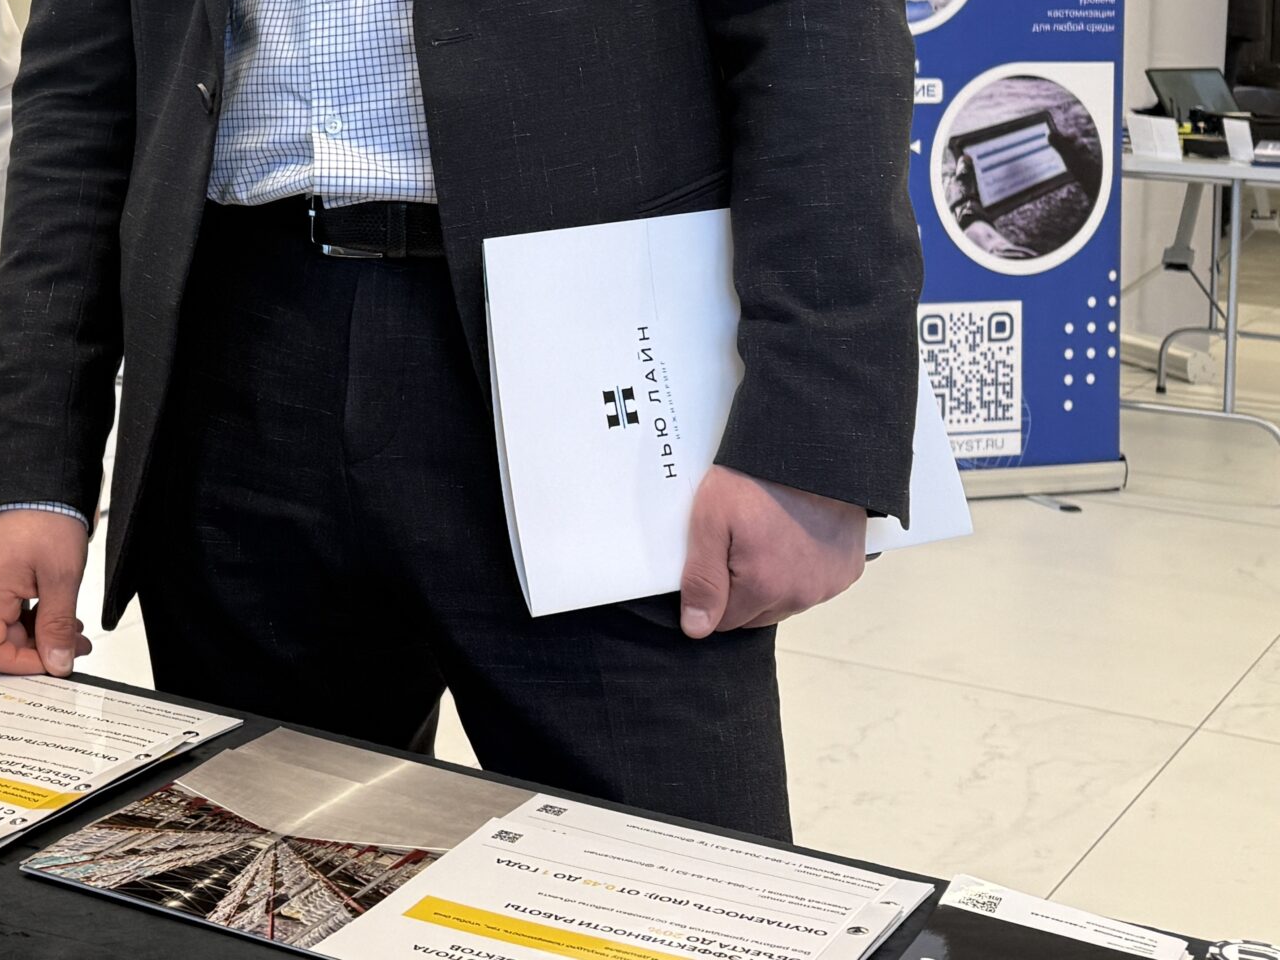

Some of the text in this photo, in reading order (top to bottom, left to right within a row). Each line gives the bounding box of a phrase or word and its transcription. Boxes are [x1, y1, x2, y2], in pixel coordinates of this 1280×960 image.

[1047, 9, 1115, 19] кастомизации
[1032, 21, 1115, 33] для любой среды
[637, 326, 677, 479] НЬЮ ЛАЙН
[23, 738, 118, 761] ОКУПАЕМОСТЬ
[20, 763, 80, 781] ОБЪЕКТА
[31, 774, 71, 787] РОСТ
[496, 857, 539, 872] ГОДА
[552, 872, 582, 882] ДО
[616, 886, 640, 895] ОТ
[643, 892, 689, 906] (ROI):
[693, 903, 827, 936] ОКУПАЕМОСТЬ
[504, 902, 741, 960] ЭФФЕКТИВНОСТИ РАБОТЫ
[685, 935, 717, 945] ДО
